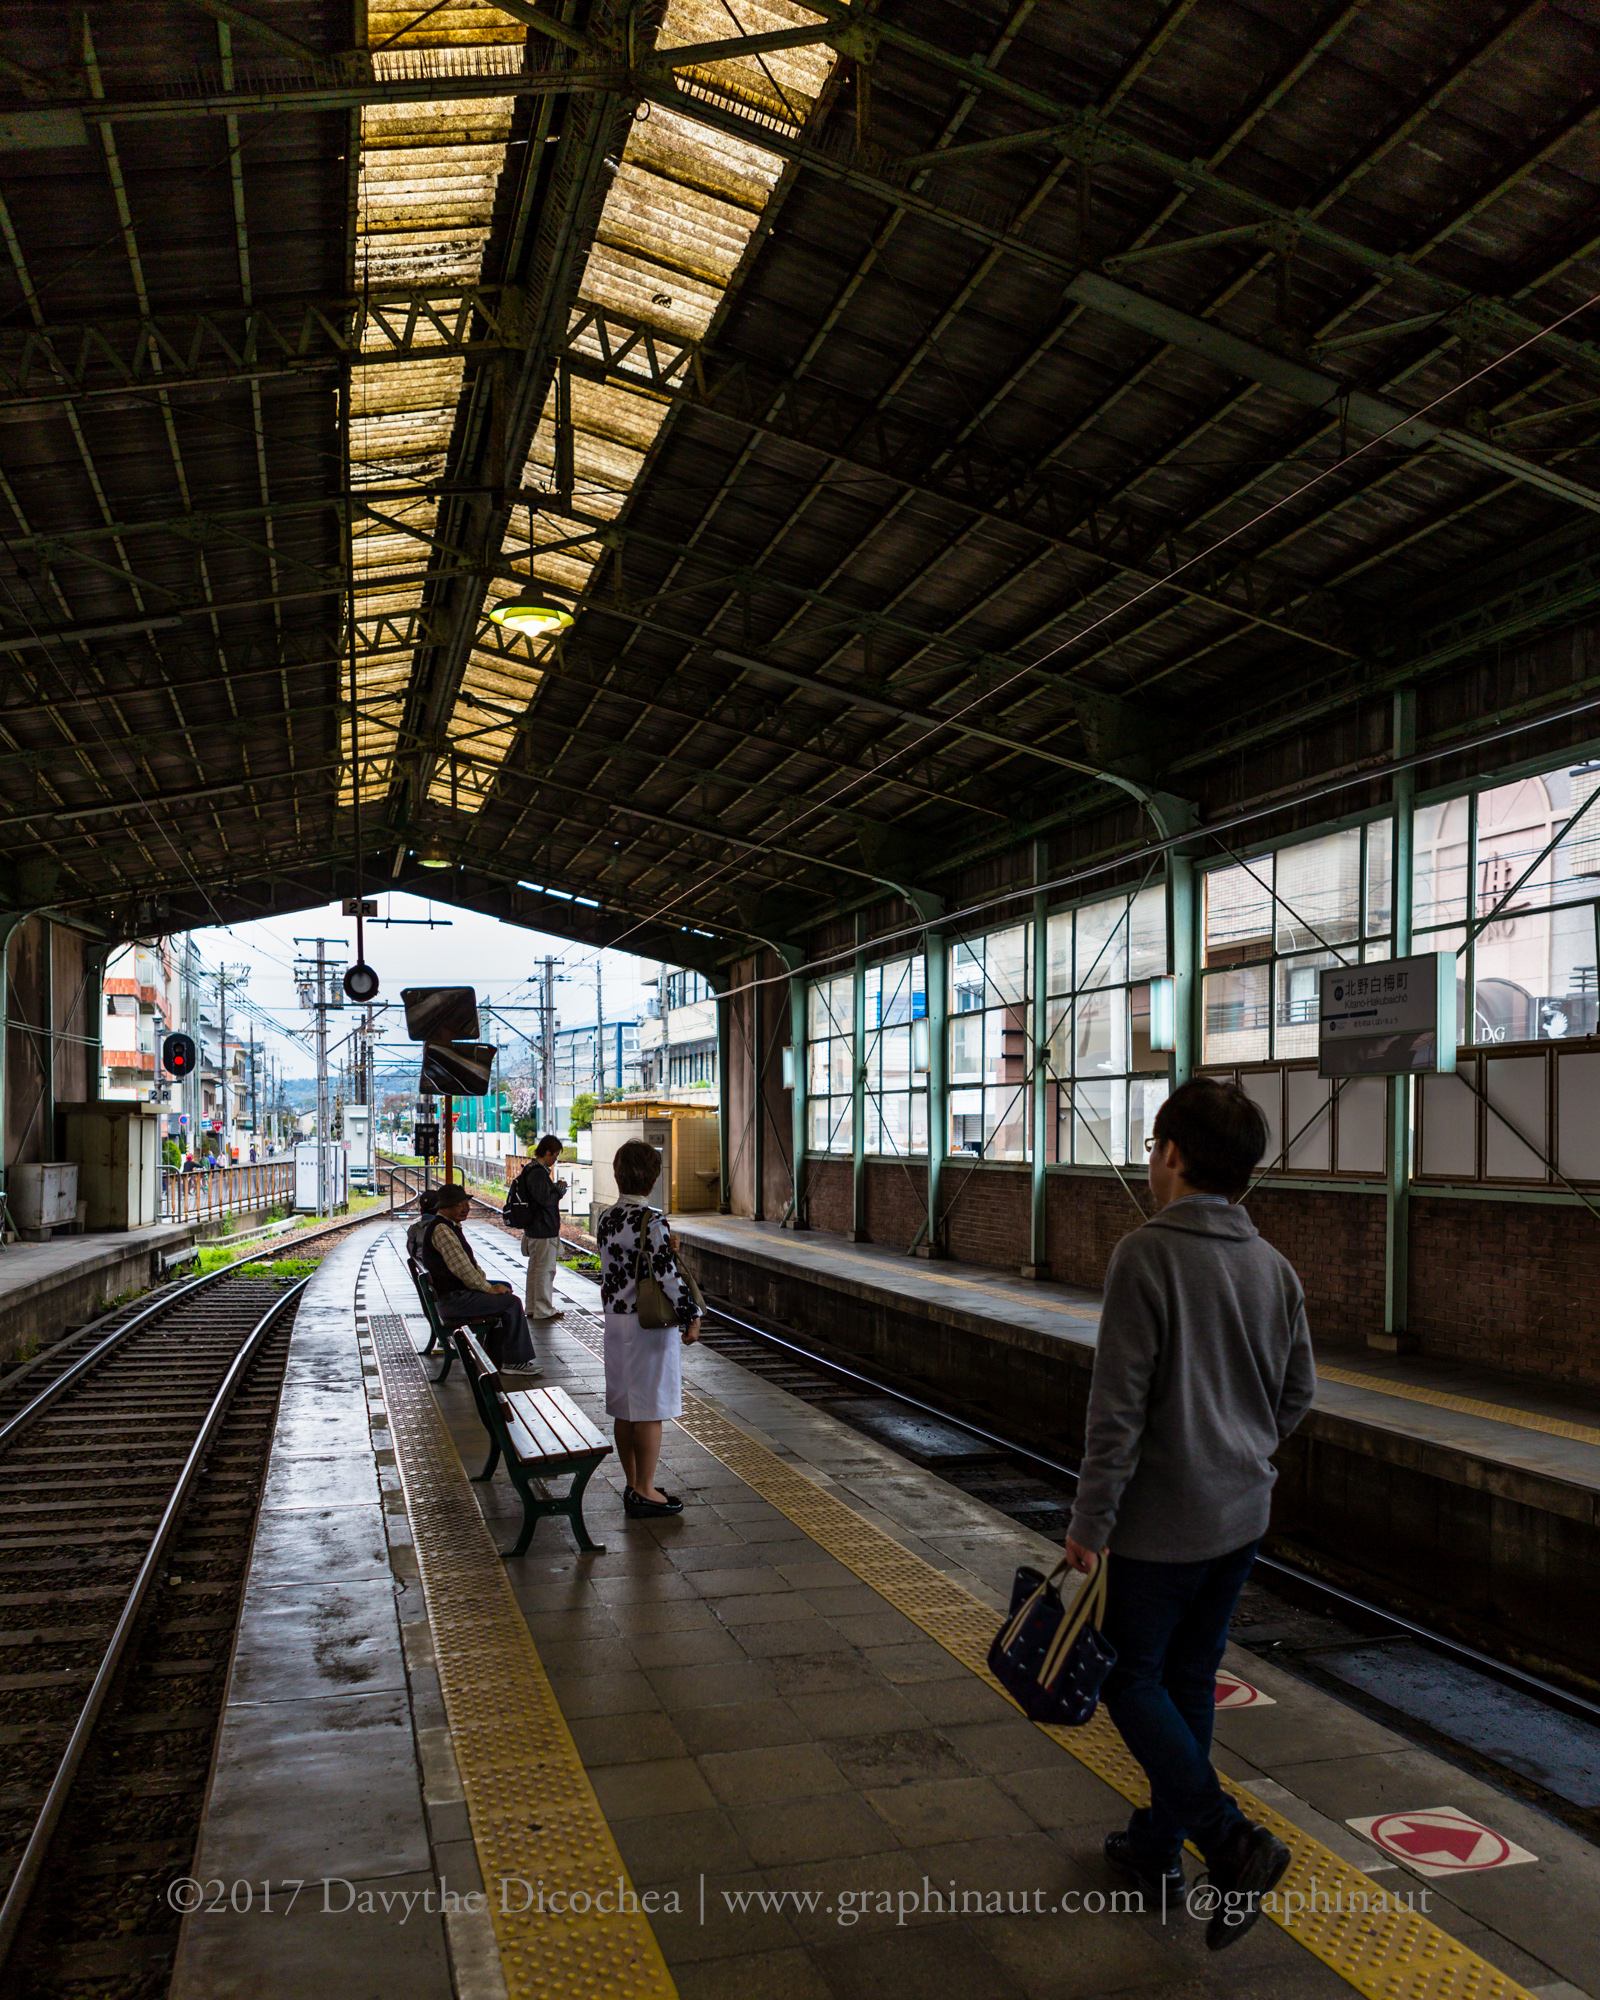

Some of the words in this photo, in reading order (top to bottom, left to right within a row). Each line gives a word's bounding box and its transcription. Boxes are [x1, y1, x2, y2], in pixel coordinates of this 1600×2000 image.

[1345, 972, 1409, 997] 北野白梅町
[1344, 993, 1408, 1009] Kitano-Hakubaichō
[1353, 1016, 1399, 1028] きたのはくばいちょう
